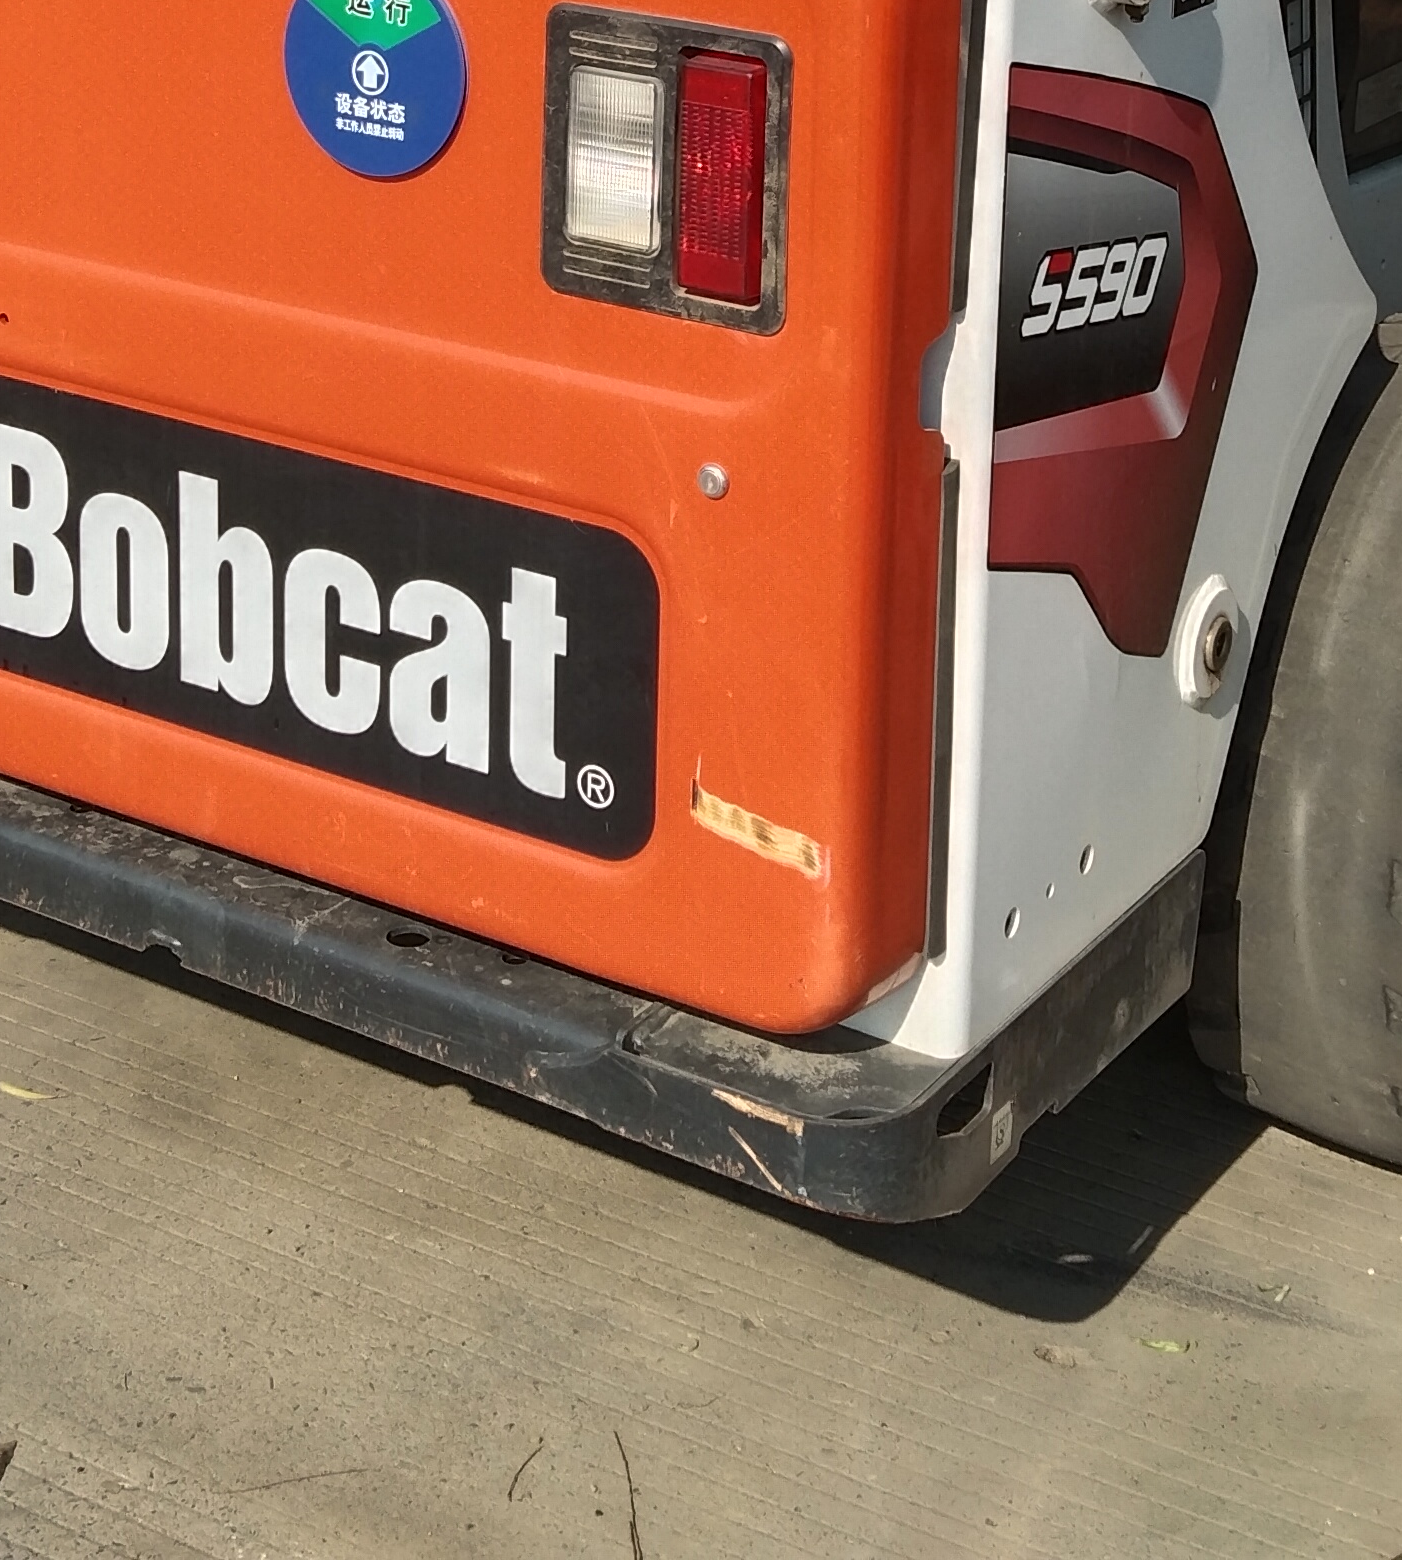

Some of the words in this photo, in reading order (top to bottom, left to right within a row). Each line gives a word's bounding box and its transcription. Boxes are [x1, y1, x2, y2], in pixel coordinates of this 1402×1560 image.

[335, 93, 406, 124] 设备状态
[1021, 237, 1168, 338] S590
